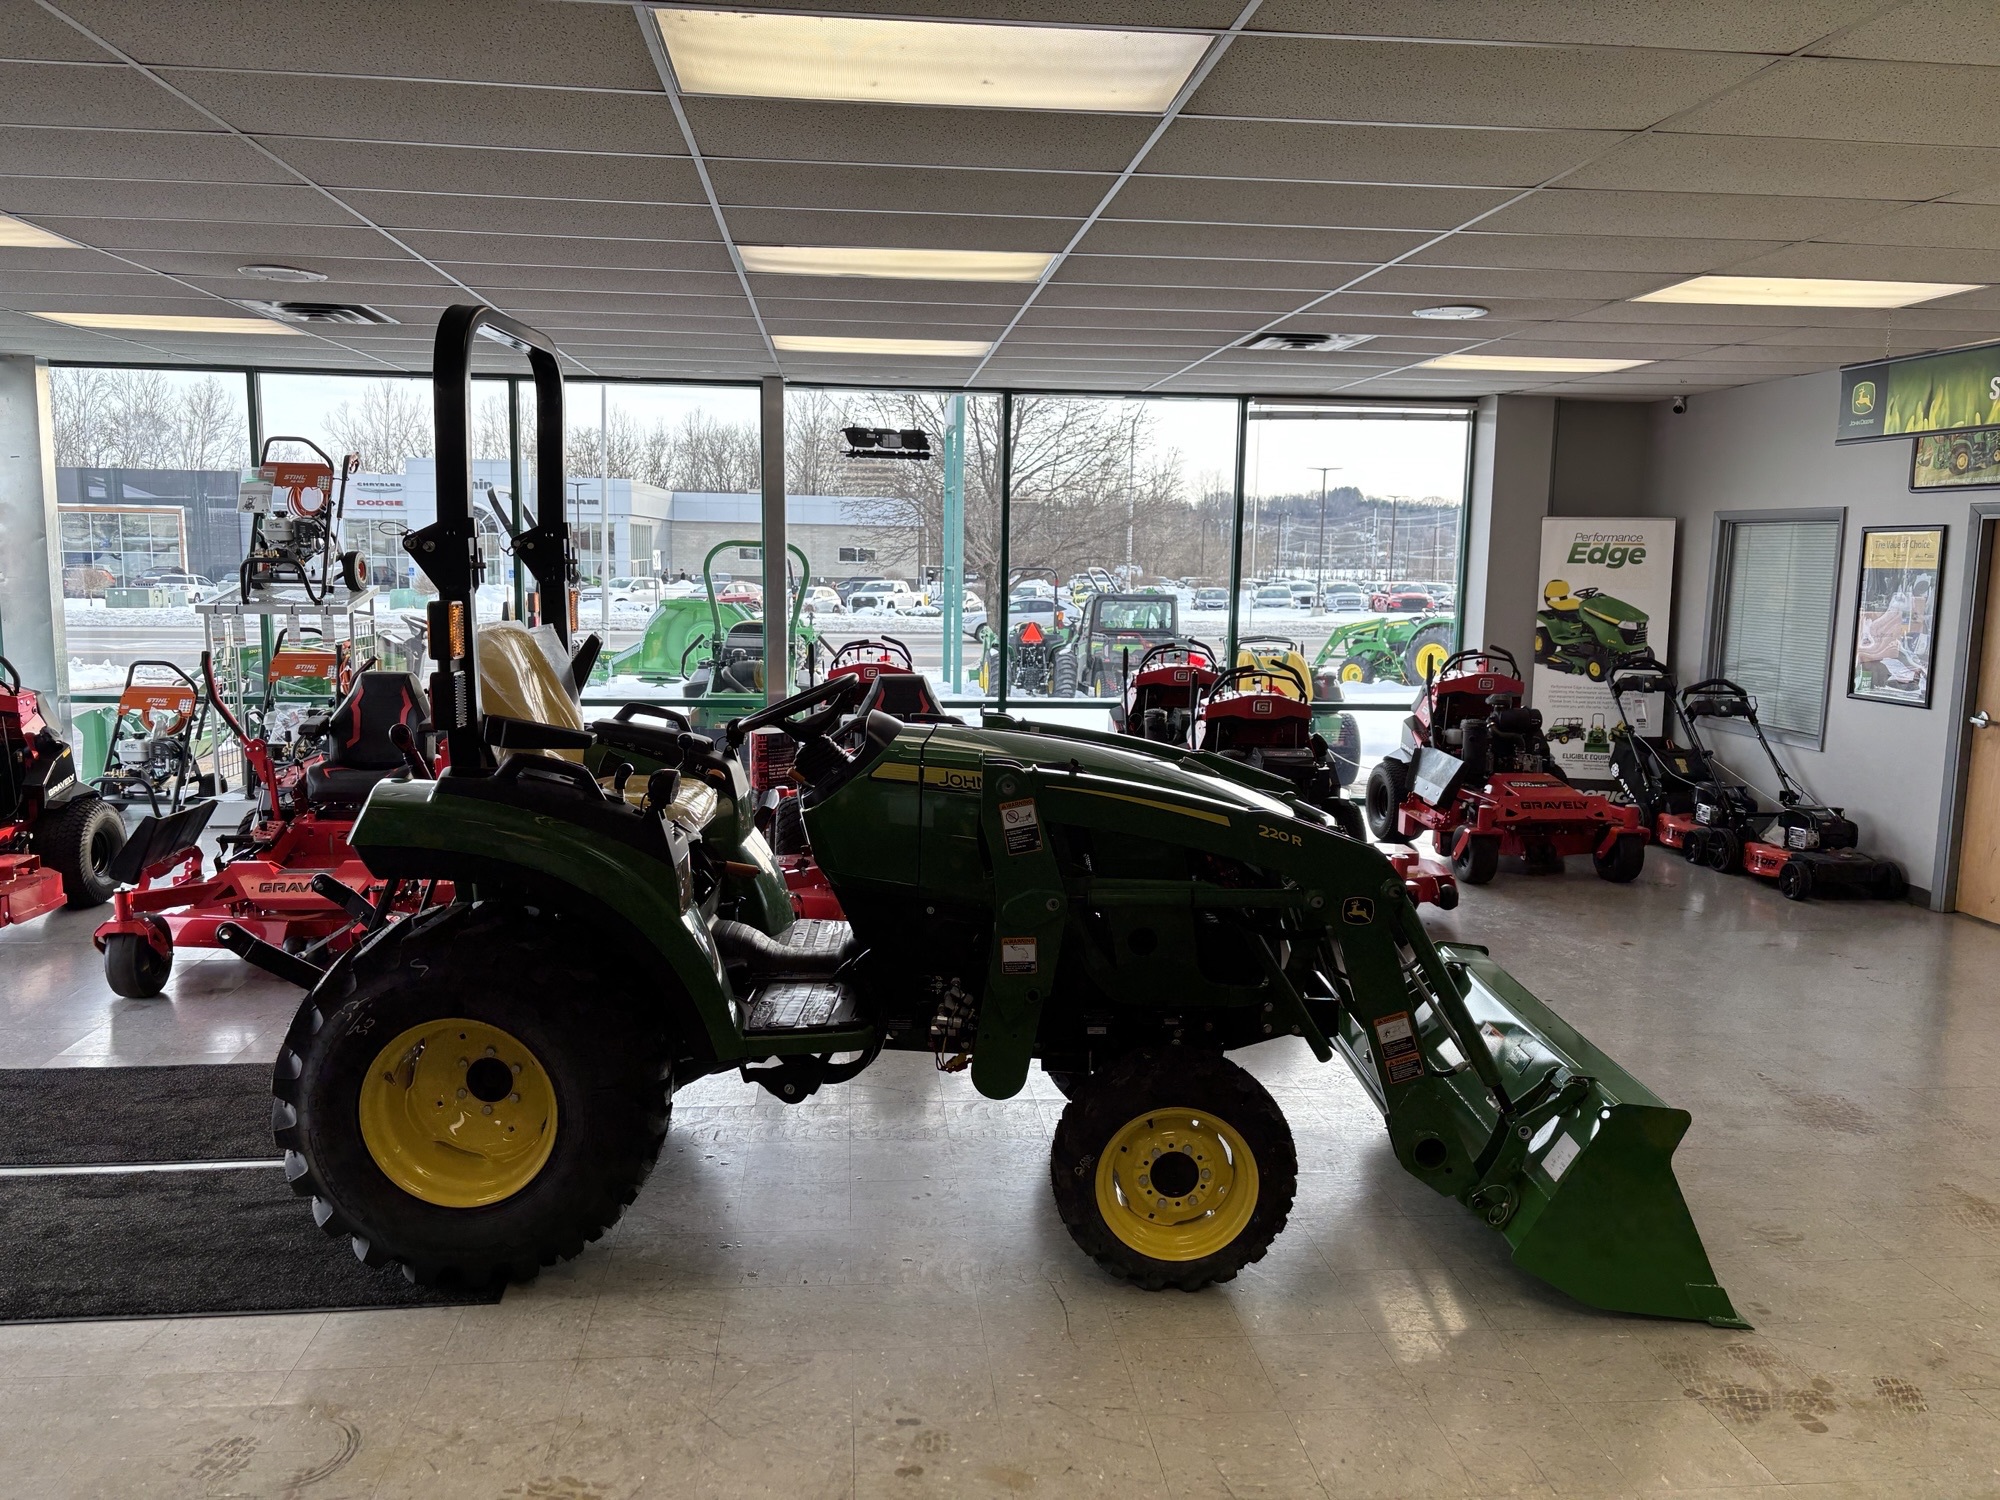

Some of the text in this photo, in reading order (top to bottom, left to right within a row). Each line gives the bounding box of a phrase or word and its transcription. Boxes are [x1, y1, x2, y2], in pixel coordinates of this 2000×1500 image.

[1574, 532, 1644, 543] Performance
[1909, 539, 1931, 549] Choice
[1567, 542, 1647, 569] Edge
[758, 735, 768, 758] THE
[48, 773, 75, 797] GRAVELY
[1006, 800, 1033, 809] WARNING
[1520, 801, 1589, 810] GRAVELY
[1259, 824, 1302, 847] 220 R
[258, 882, 313, 893] GRAV
